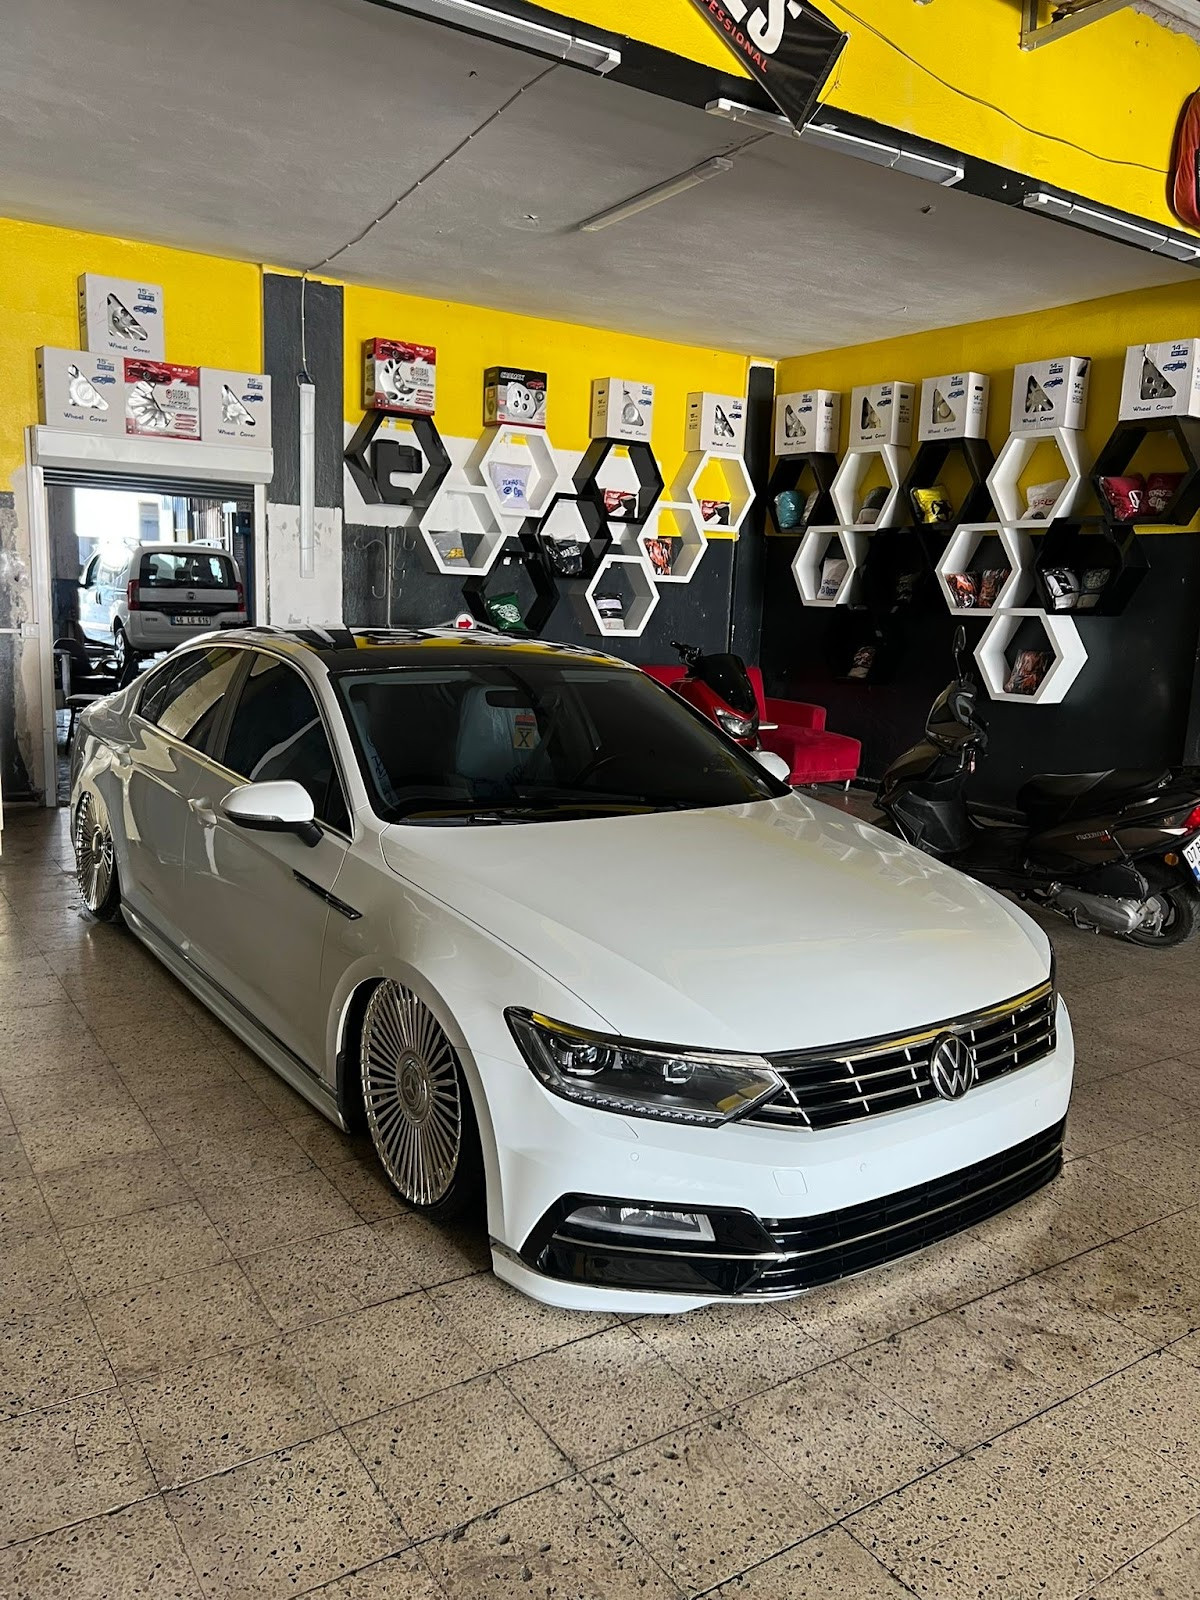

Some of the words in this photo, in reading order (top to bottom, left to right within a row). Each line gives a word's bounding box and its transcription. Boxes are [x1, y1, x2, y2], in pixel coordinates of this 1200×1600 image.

[703, 0, 769, 73] ESSIONAL
[108, 341, 128, 350] Wheel
[133, 345, 150, 354] Cover
[63, 412, 84, 421] Wheel
[89, 415, 107, 423] Cover
[1039, 415, 1055, 423] Cover
[217, 428, 236, 437] Wheel
[240, 430, 256, 438] Cover
